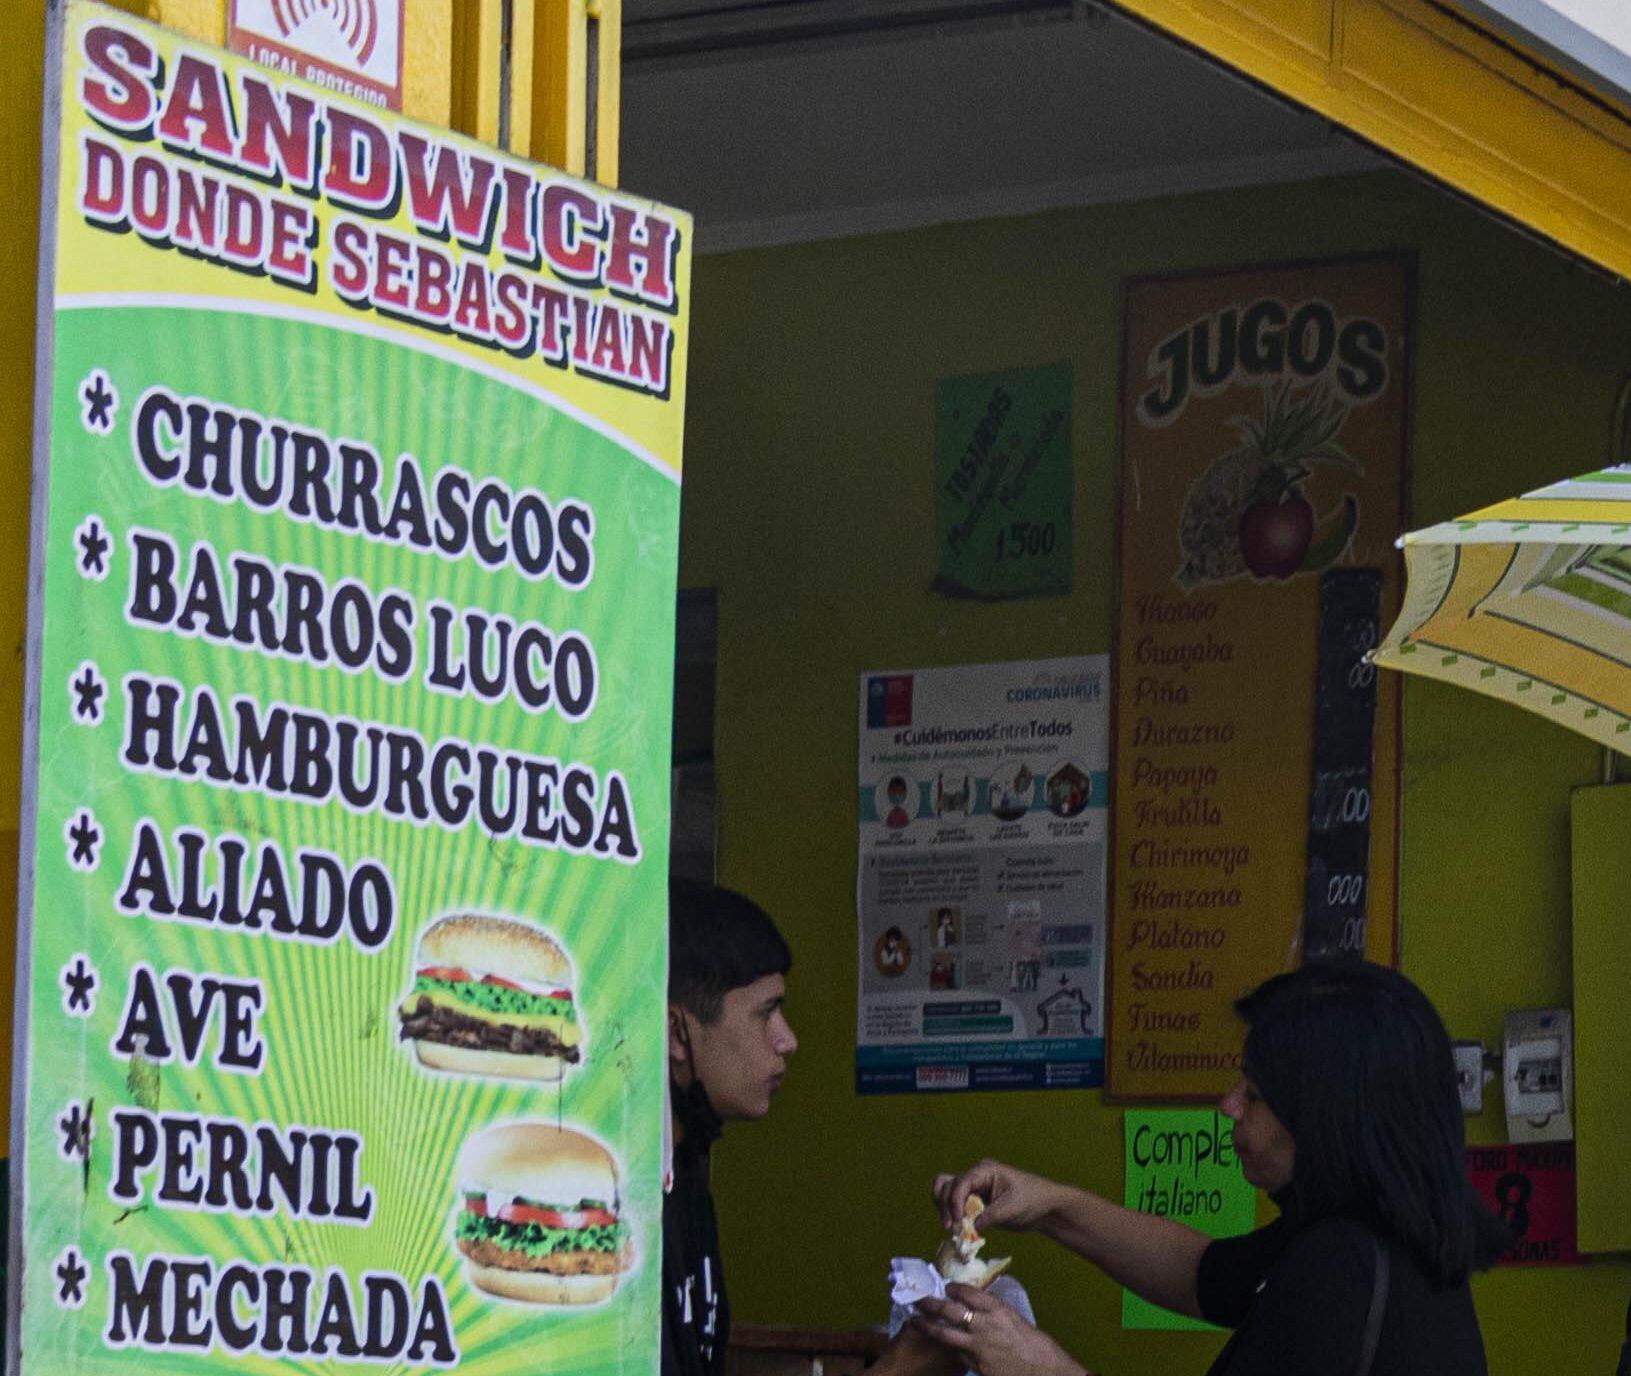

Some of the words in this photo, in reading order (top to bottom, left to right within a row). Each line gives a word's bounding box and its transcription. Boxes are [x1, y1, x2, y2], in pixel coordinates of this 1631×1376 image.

[82, 25, 676, 304] SANDWICH
[82, 138, 313, 282] DONDE
[332, 222, 668, 391] SEBASTIAN
[1144, 300, 1387, 420] JUGOS
[136, 393, 592, 585] CHURRASCOS
[131, 533, 413, 677] BARROS
[429, 606, 595, 718] LUCO
[1135, 634, 1233, 672] Guayaba
[1006, 683, 1101, 703] CORONAVIRUS
[1132, 716, 1236, 748] Durazno
[124, 680, 640, 859] HAMBURGUESA
[1132, 756, 1218, 794] Papaya
[1134, 797, 1223, 828] Frutilla
[119, 823, 394, 948] ALIADO
[1129, 839, 1249, 876] Chirimoya
[116, 968, 264, 1070] AVE
[111, 1111, 373, 1221] PERNIL
[1132, 1110, 1242, 1181] Comple
[1138, 1175, 1223, 1217] italiano
[106, 1256, 458, 1365] MECHADA
